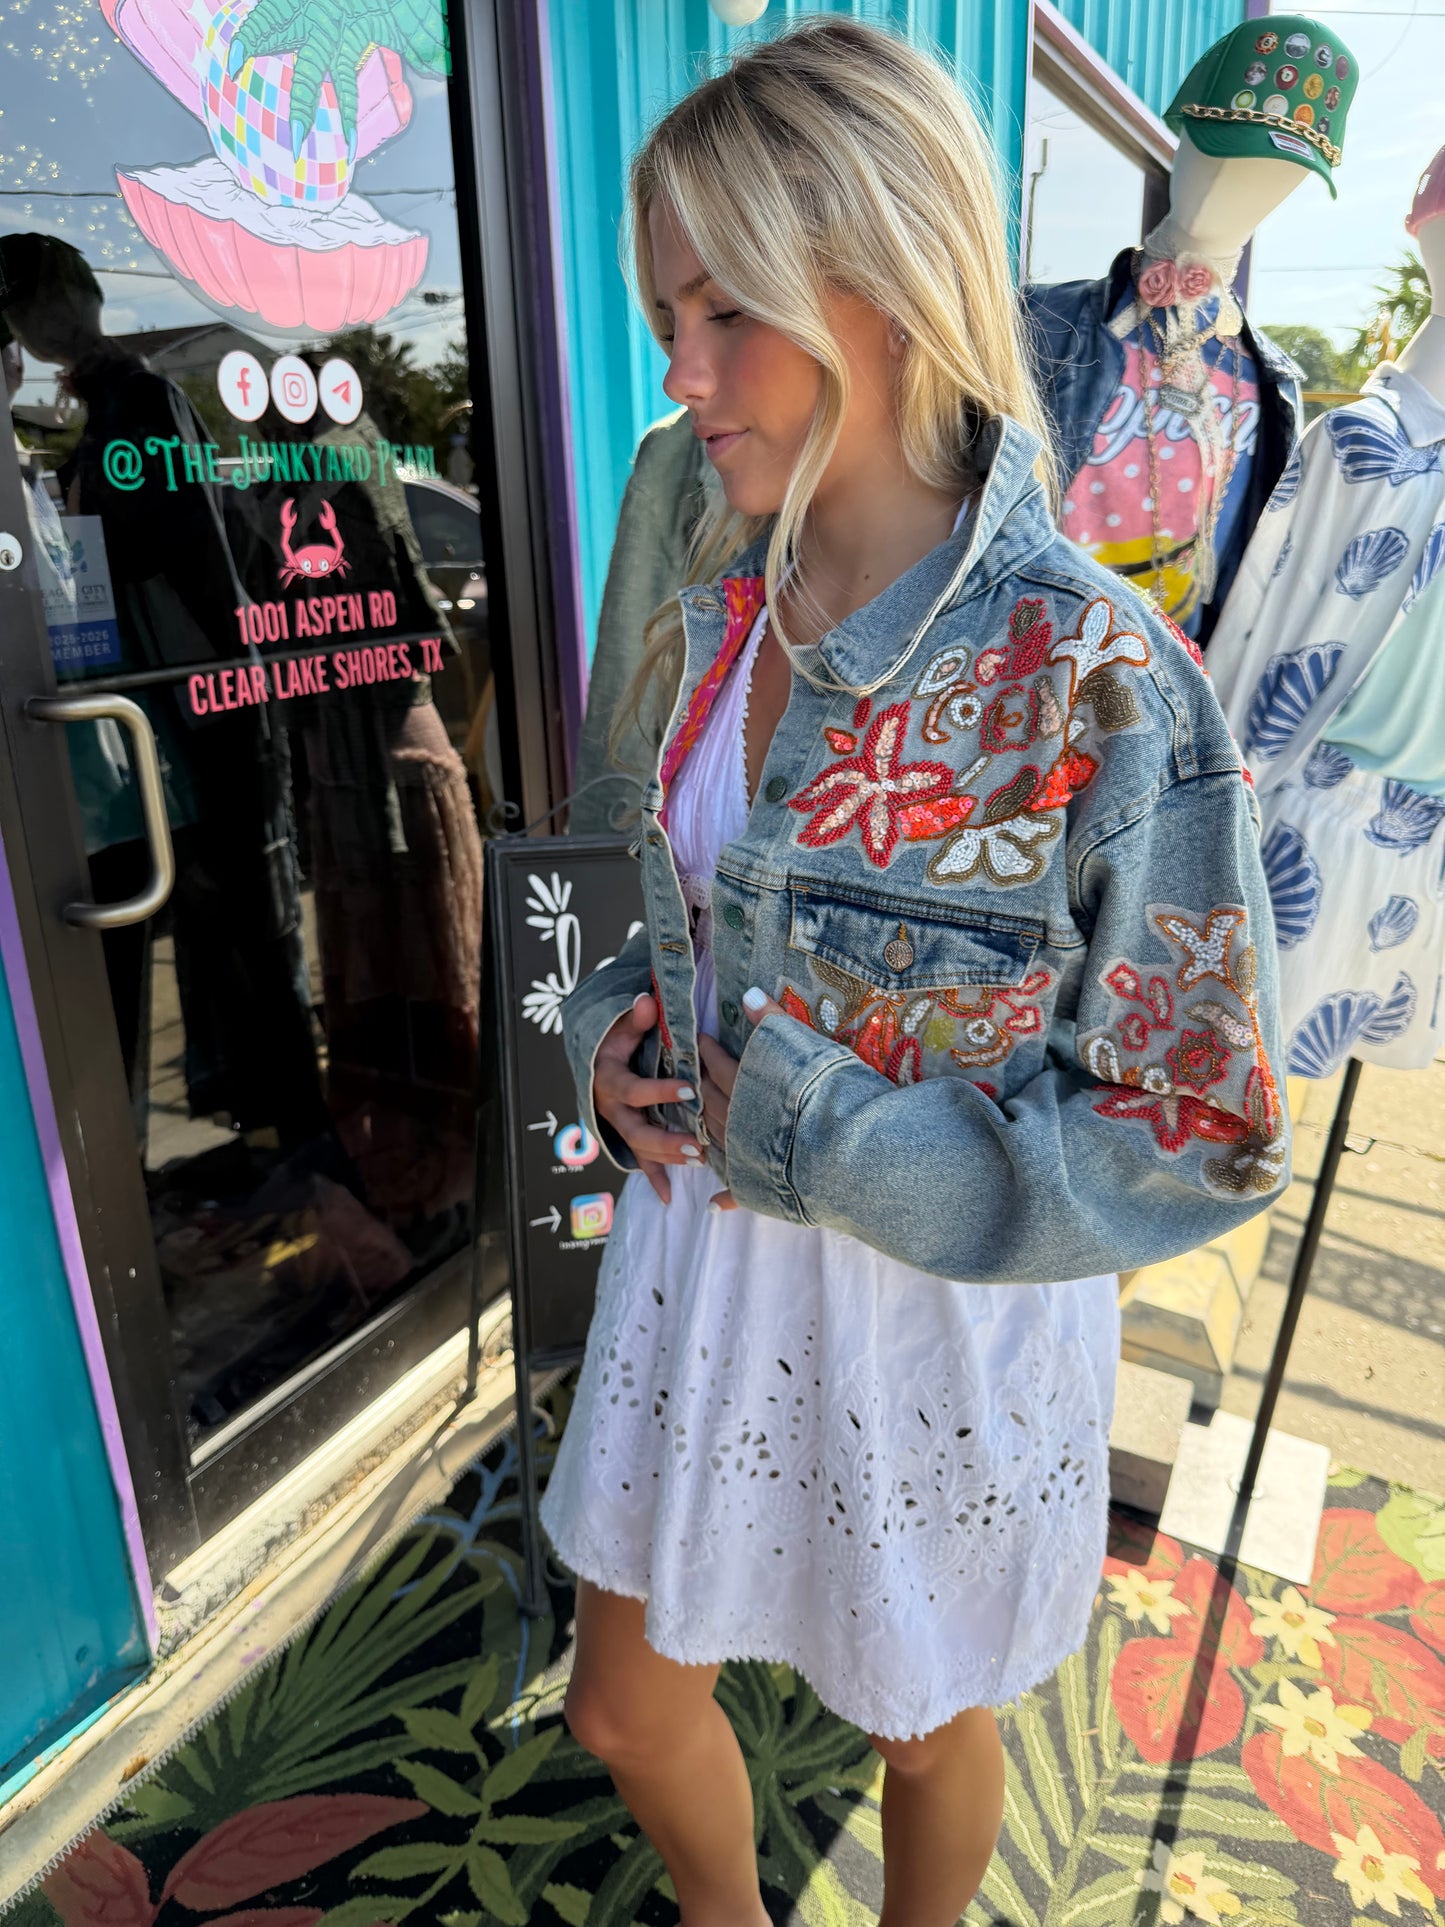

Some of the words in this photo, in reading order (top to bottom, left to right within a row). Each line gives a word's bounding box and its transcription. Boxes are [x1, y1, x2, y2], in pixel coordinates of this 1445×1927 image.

[103, 435, 224, 491] @THE
[231, 434, 371, 490] JUNKYARD
[235, 602, 289, 645] 1001
[296, 593, 365, 638] ASPEN
[368, 590, 397, 628] RD
[188, 665, 269, 715] CLEAR
[272, 655, 330, 700] LAKE
[333, 643, 417, 689] SHORES,
[420, 638, 444, 673] TX
